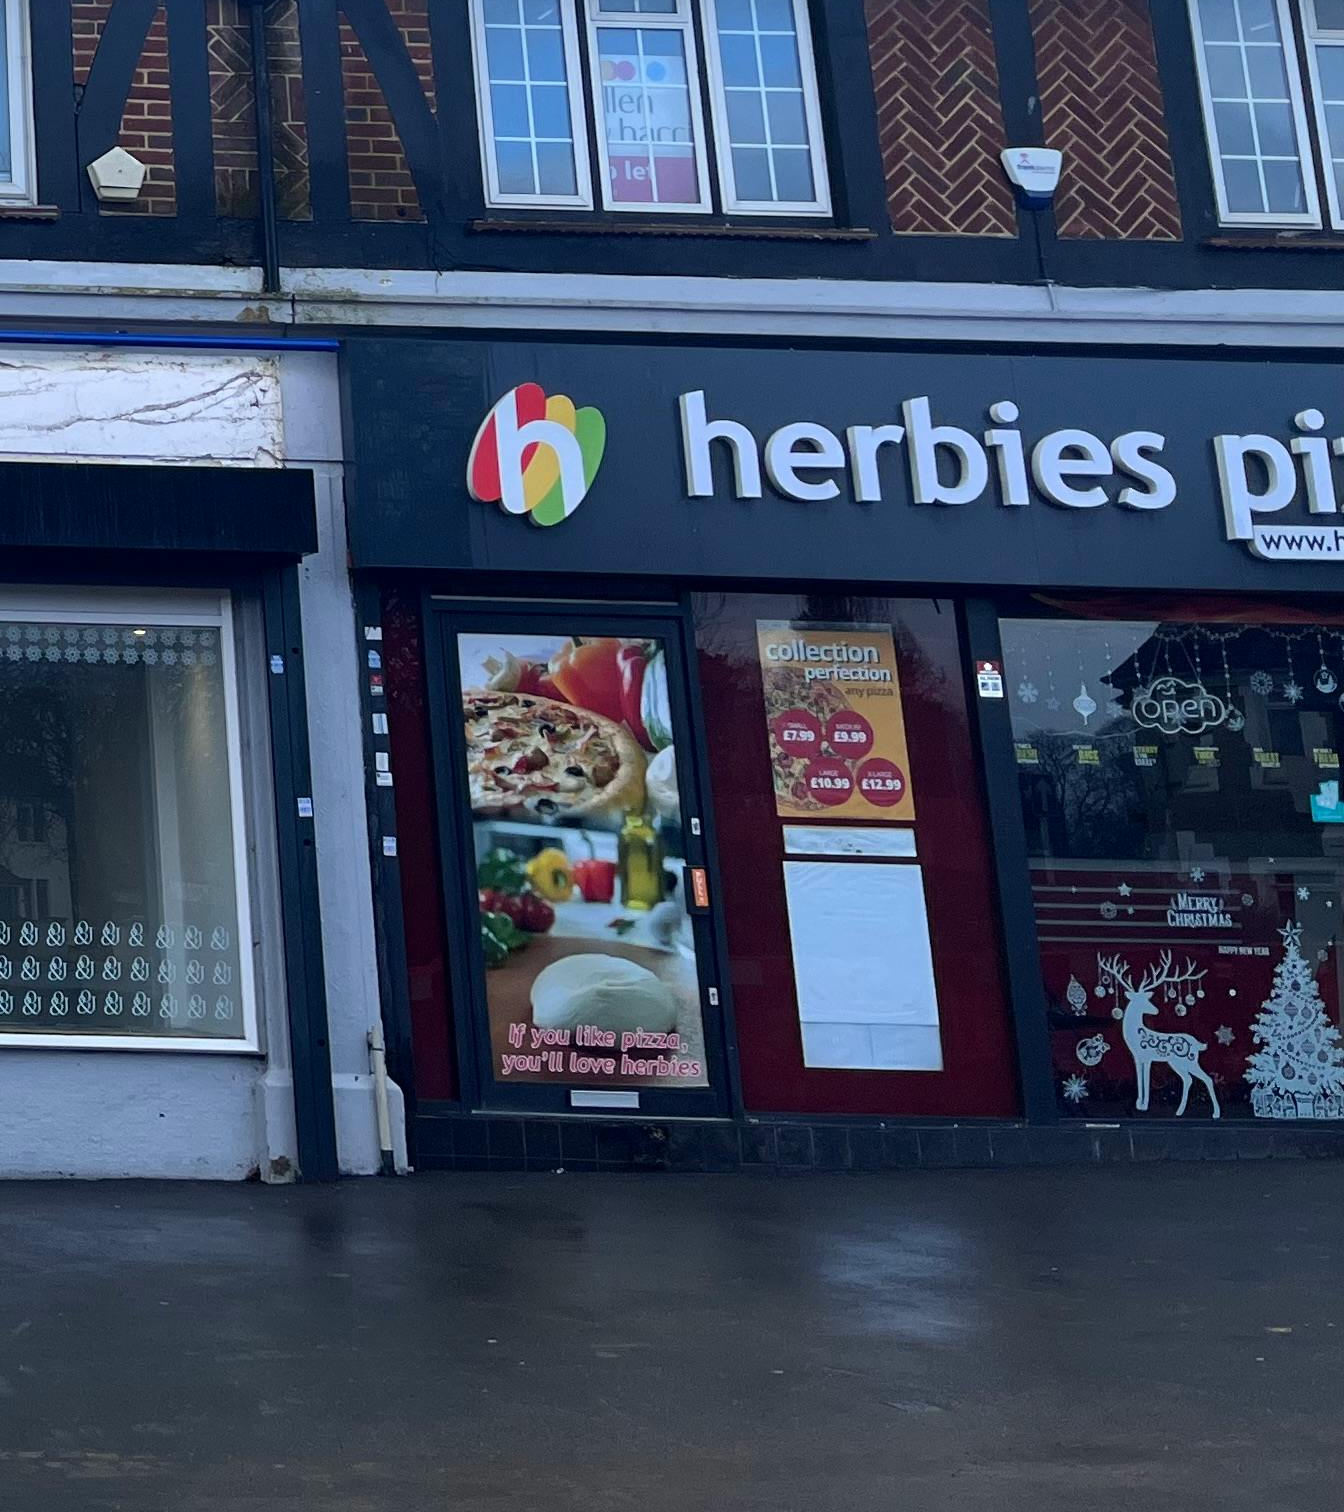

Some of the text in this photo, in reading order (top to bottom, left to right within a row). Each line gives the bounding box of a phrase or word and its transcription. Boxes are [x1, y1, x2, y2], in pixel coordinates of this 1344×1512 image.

[678, 390, 1344, 541] herbies pi
[765, 640, 880, 664] collection
[805, 664, 892, 682] perfection
[867, 689, 894, 698] pizza
[1141, 699, 1217, 724] open
[783, 730, 867, 743] £7.99 £9.99
[810, 777, 902, 790] £10.99 £12.99
[1177, 892, 1218, 913] MERRY
[1167, 909, 1232, 928] CHRISTMAS
[508, 1023, 689, 1054] If you like pizza,
[501, 1051, 702, 1077] you'll love herbies
